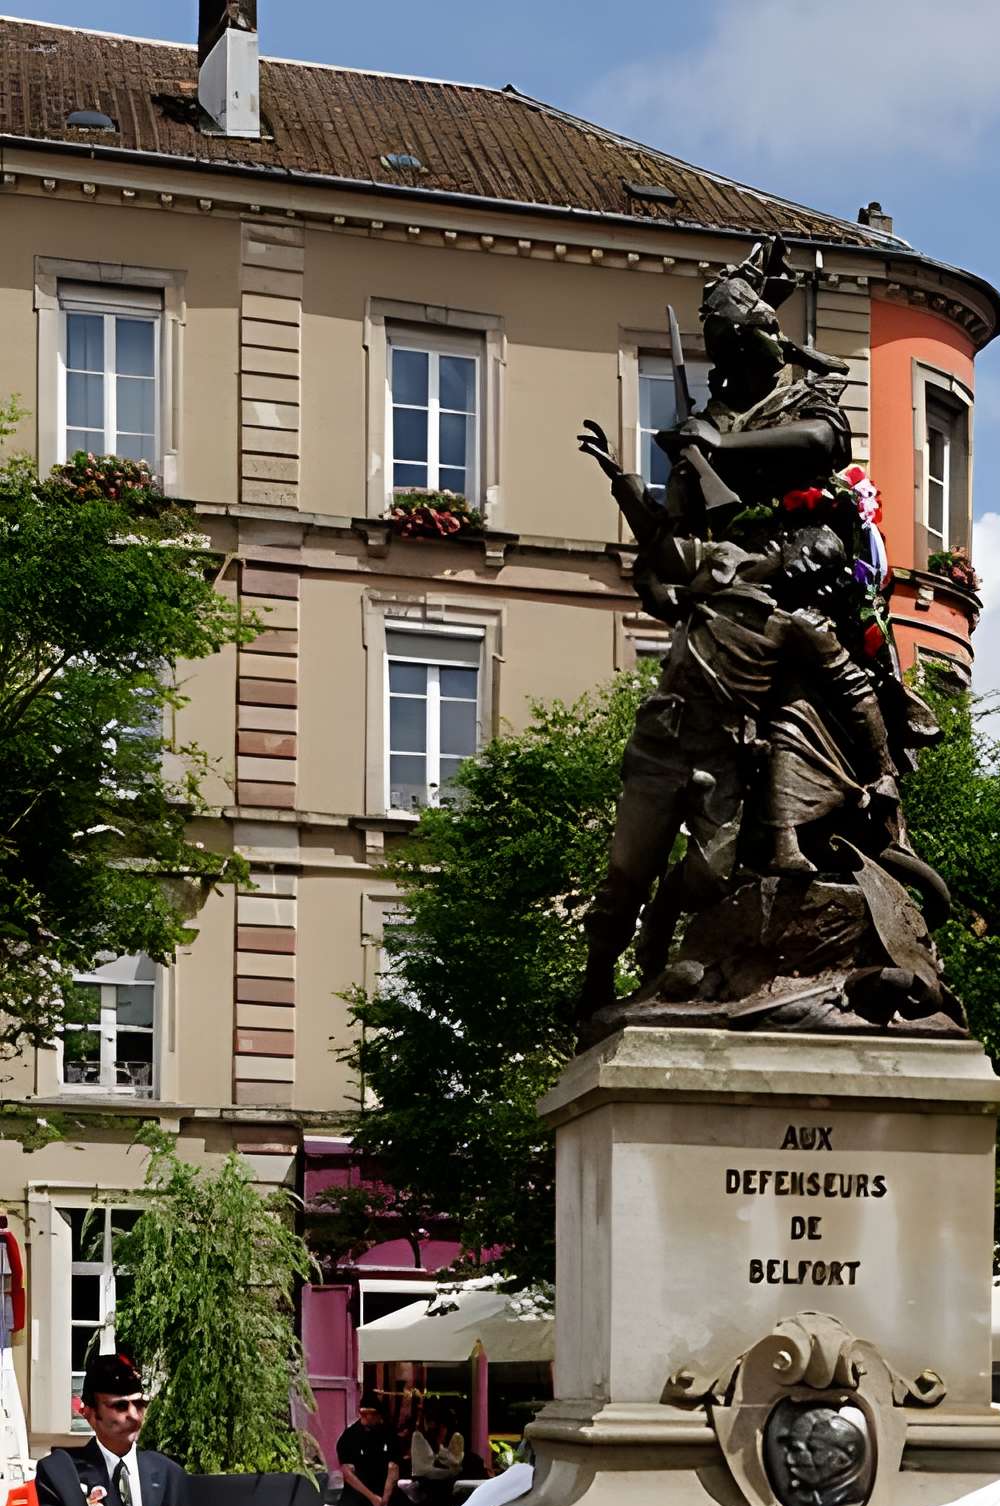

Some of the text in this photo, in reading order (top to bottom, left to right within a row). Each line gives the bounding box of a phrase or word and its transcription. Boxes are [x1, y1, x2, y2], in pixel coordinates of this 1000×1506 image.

[780, 1125, 833, 1151] AUX
[726, 1169, 888, 1198] DEFENSEURS
[791, 1216, 822, 1240] DE
[749, 1259, 861, 1285] BELFORT
